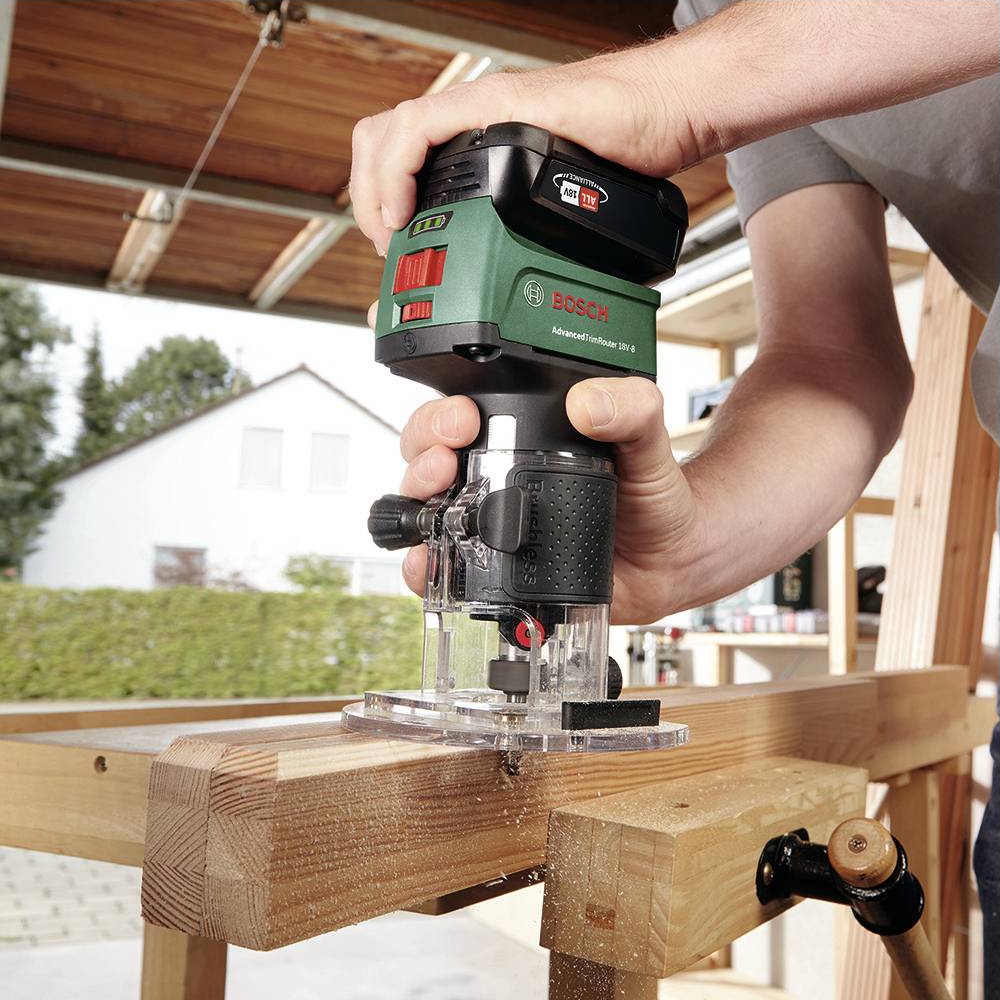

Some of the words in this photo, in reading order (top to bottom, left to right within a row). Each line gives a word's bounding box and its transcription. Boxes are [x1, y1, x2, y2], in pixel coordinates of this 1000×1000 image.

[569, 172, 595, 187] ALLIANCE
[563, 187, 577, 199] 18V
[582, 193, 596, 205] ALL
[551, 291, 610, 324] BOSCH
[552, 325, 618, 349] AdvancedTrimRouter
